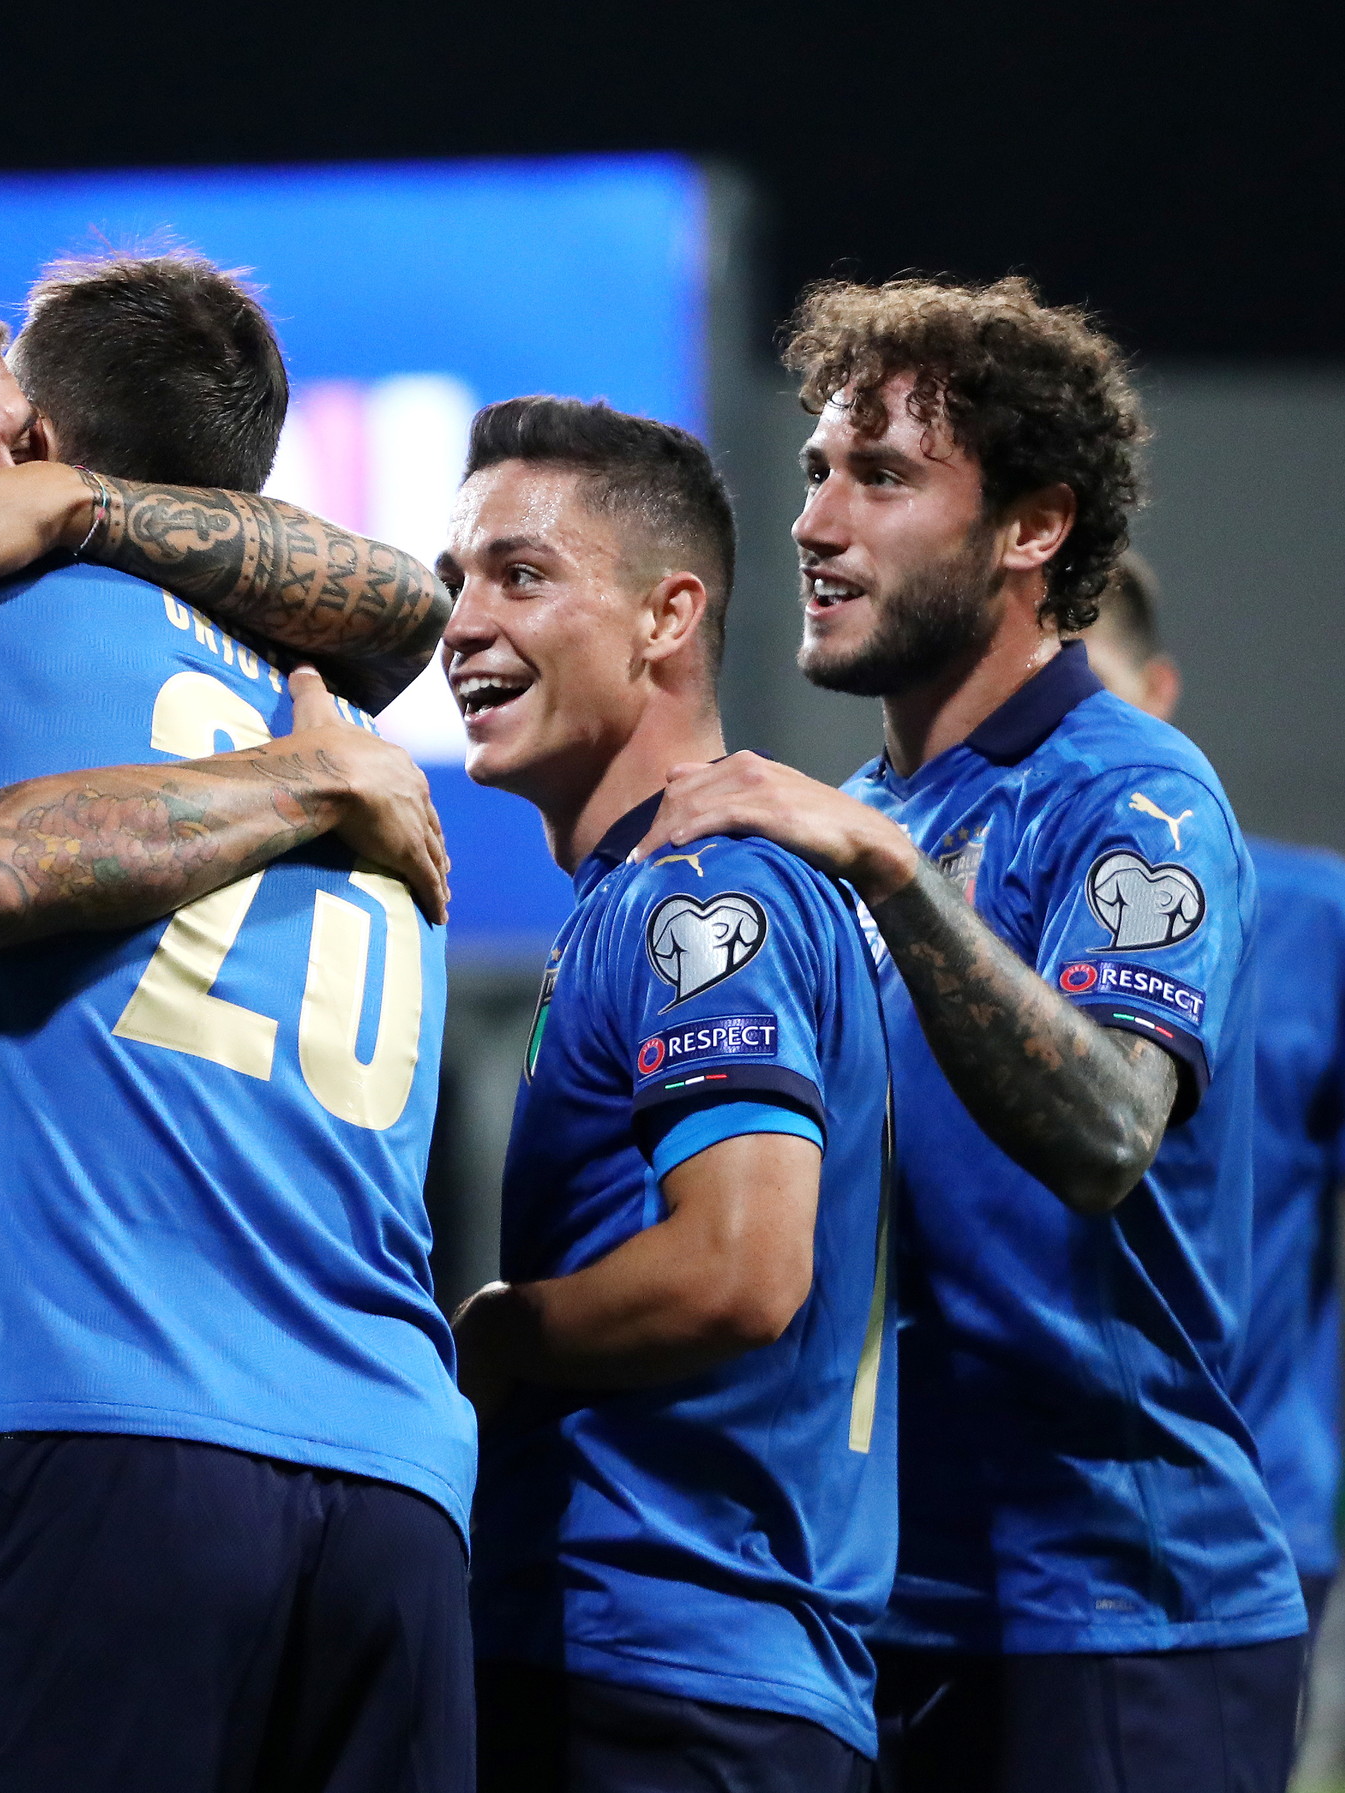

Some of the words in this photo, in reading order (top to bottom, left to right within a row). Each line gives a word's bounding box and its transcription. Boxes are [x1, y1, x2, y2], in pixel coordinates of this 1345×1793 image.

[110, 671, 422, 1131] 20
[1101, 968, 1204, 1014] RESPECT
[668, 1025, 776, 1057] RESPECT
